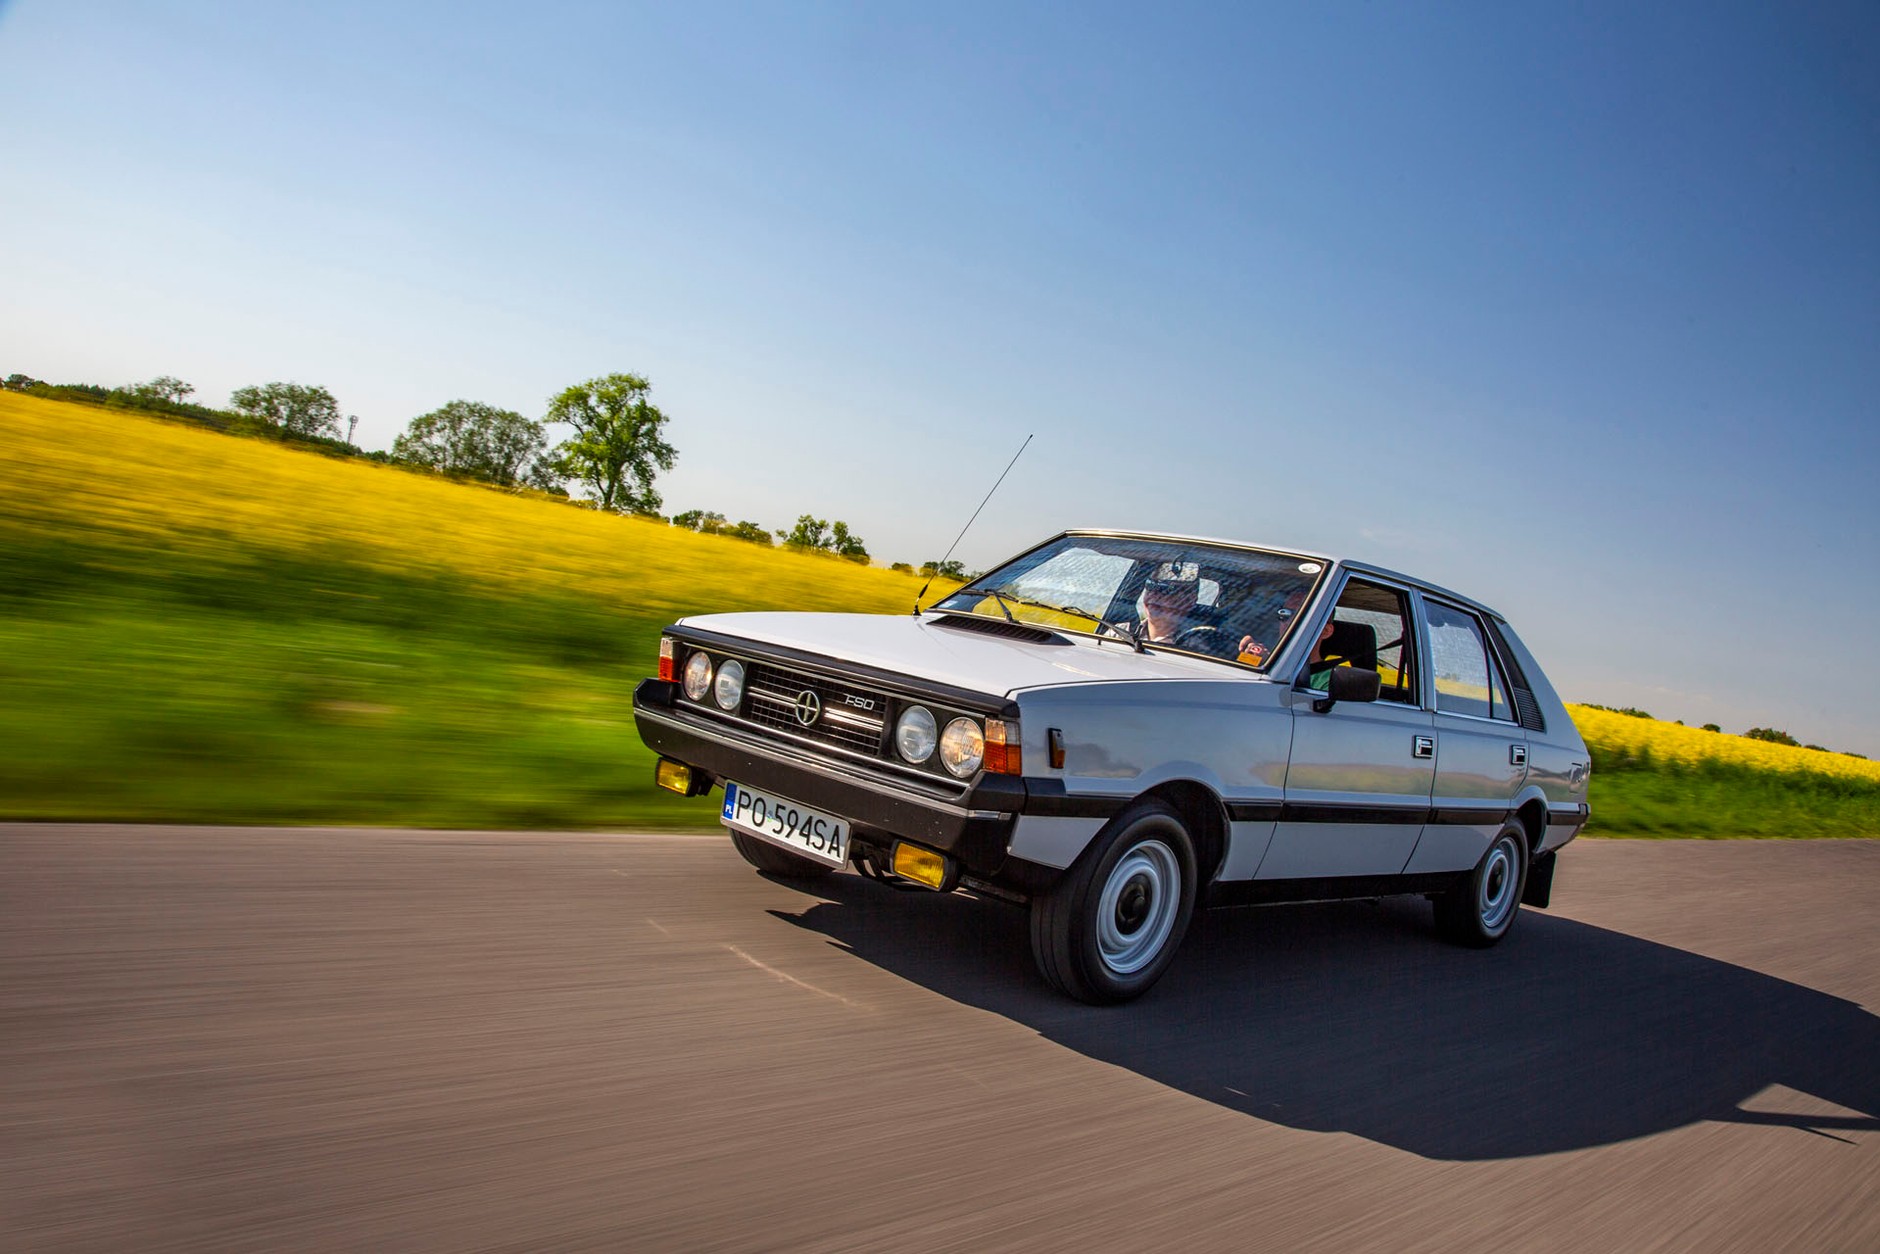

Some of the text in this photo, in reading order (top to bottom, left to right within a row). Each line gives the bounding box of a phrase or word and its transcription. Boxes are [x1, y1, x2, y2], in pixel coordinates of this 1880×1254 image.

[844, 693, 875, 710] FSO
[725, 804, 733, 814] PL
[736, 790, 841, 858] PO 594SA
